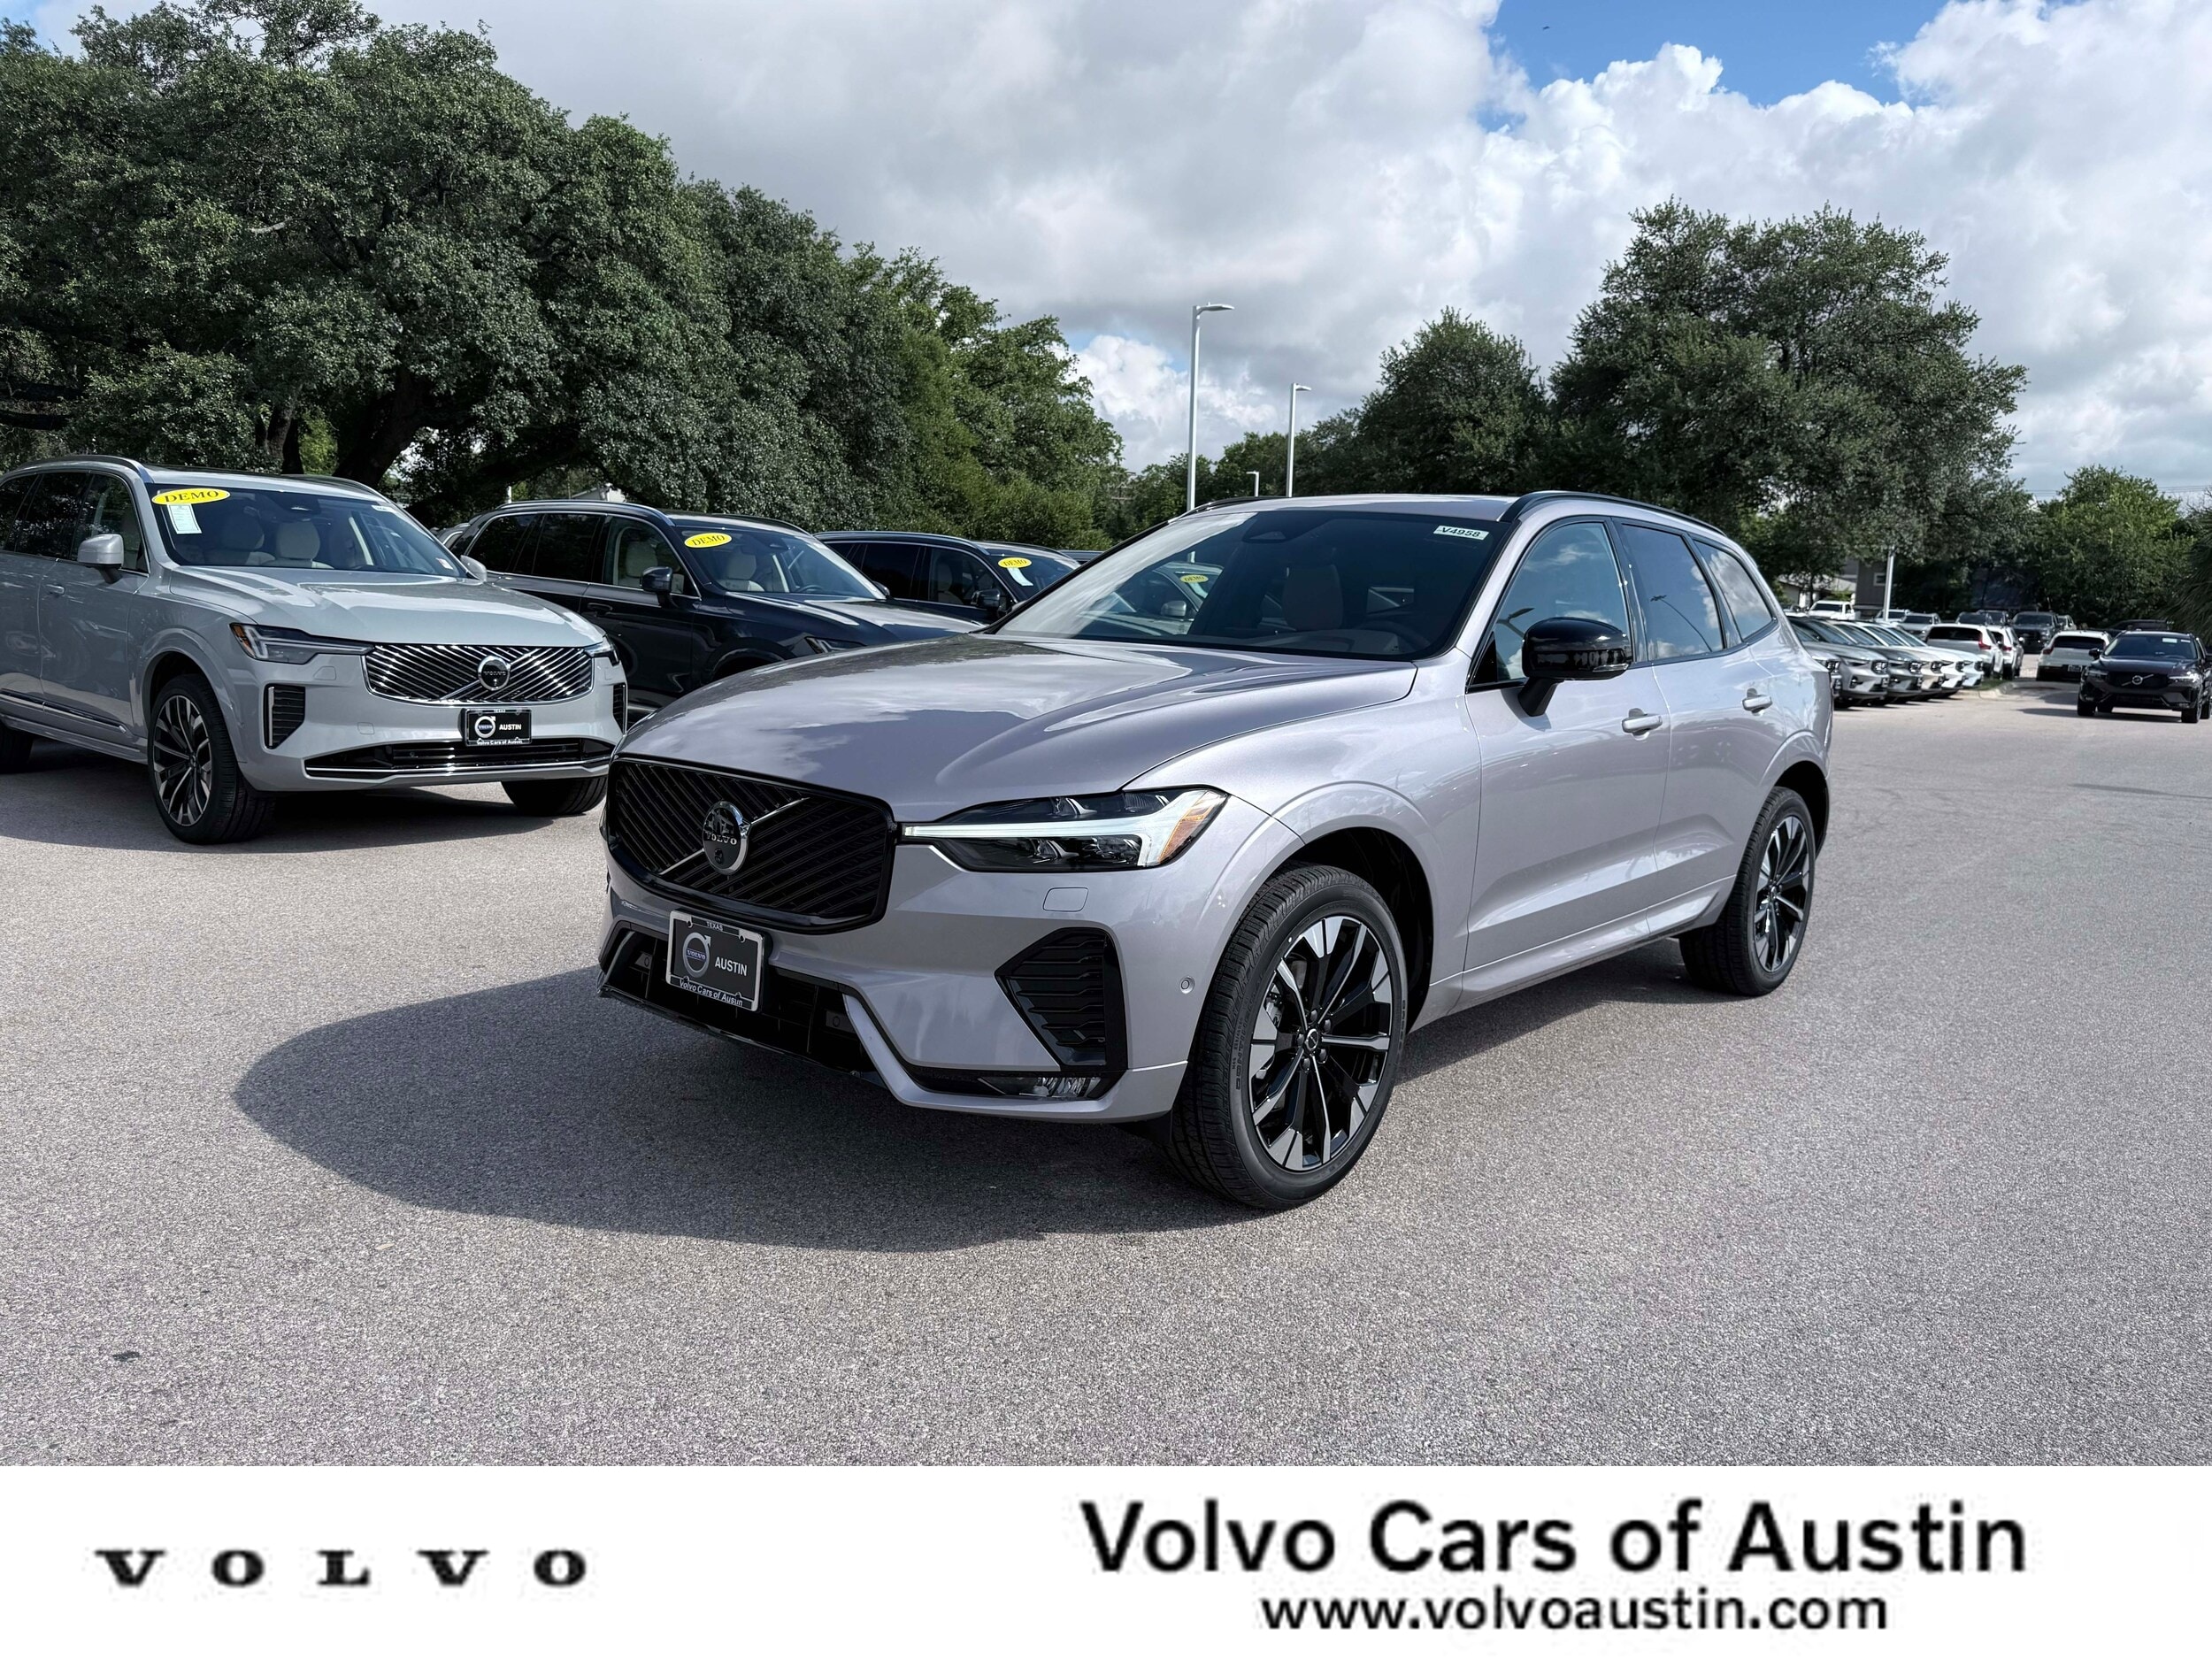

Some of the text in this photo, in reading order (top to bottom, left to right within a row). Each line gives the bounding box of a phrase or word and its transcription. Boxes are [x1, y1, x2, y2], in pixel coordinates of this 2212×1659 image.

[165, 490, 219, 503] DEMO
[1441, 526, 1481, 537] V4958
[691, 534, 726, 546] DEMO
[705, 831, 737, 845] VOLVO
[706, 921, 724, 932] TEXAS
[687, 949, 706, 960] VOLVO
[715, 956, 748, 977] AUSTIN
[679, 978, 696, 992] Volvo
[697, 985, 712, 998] Cars
[713, 990, 721, 1001] of
